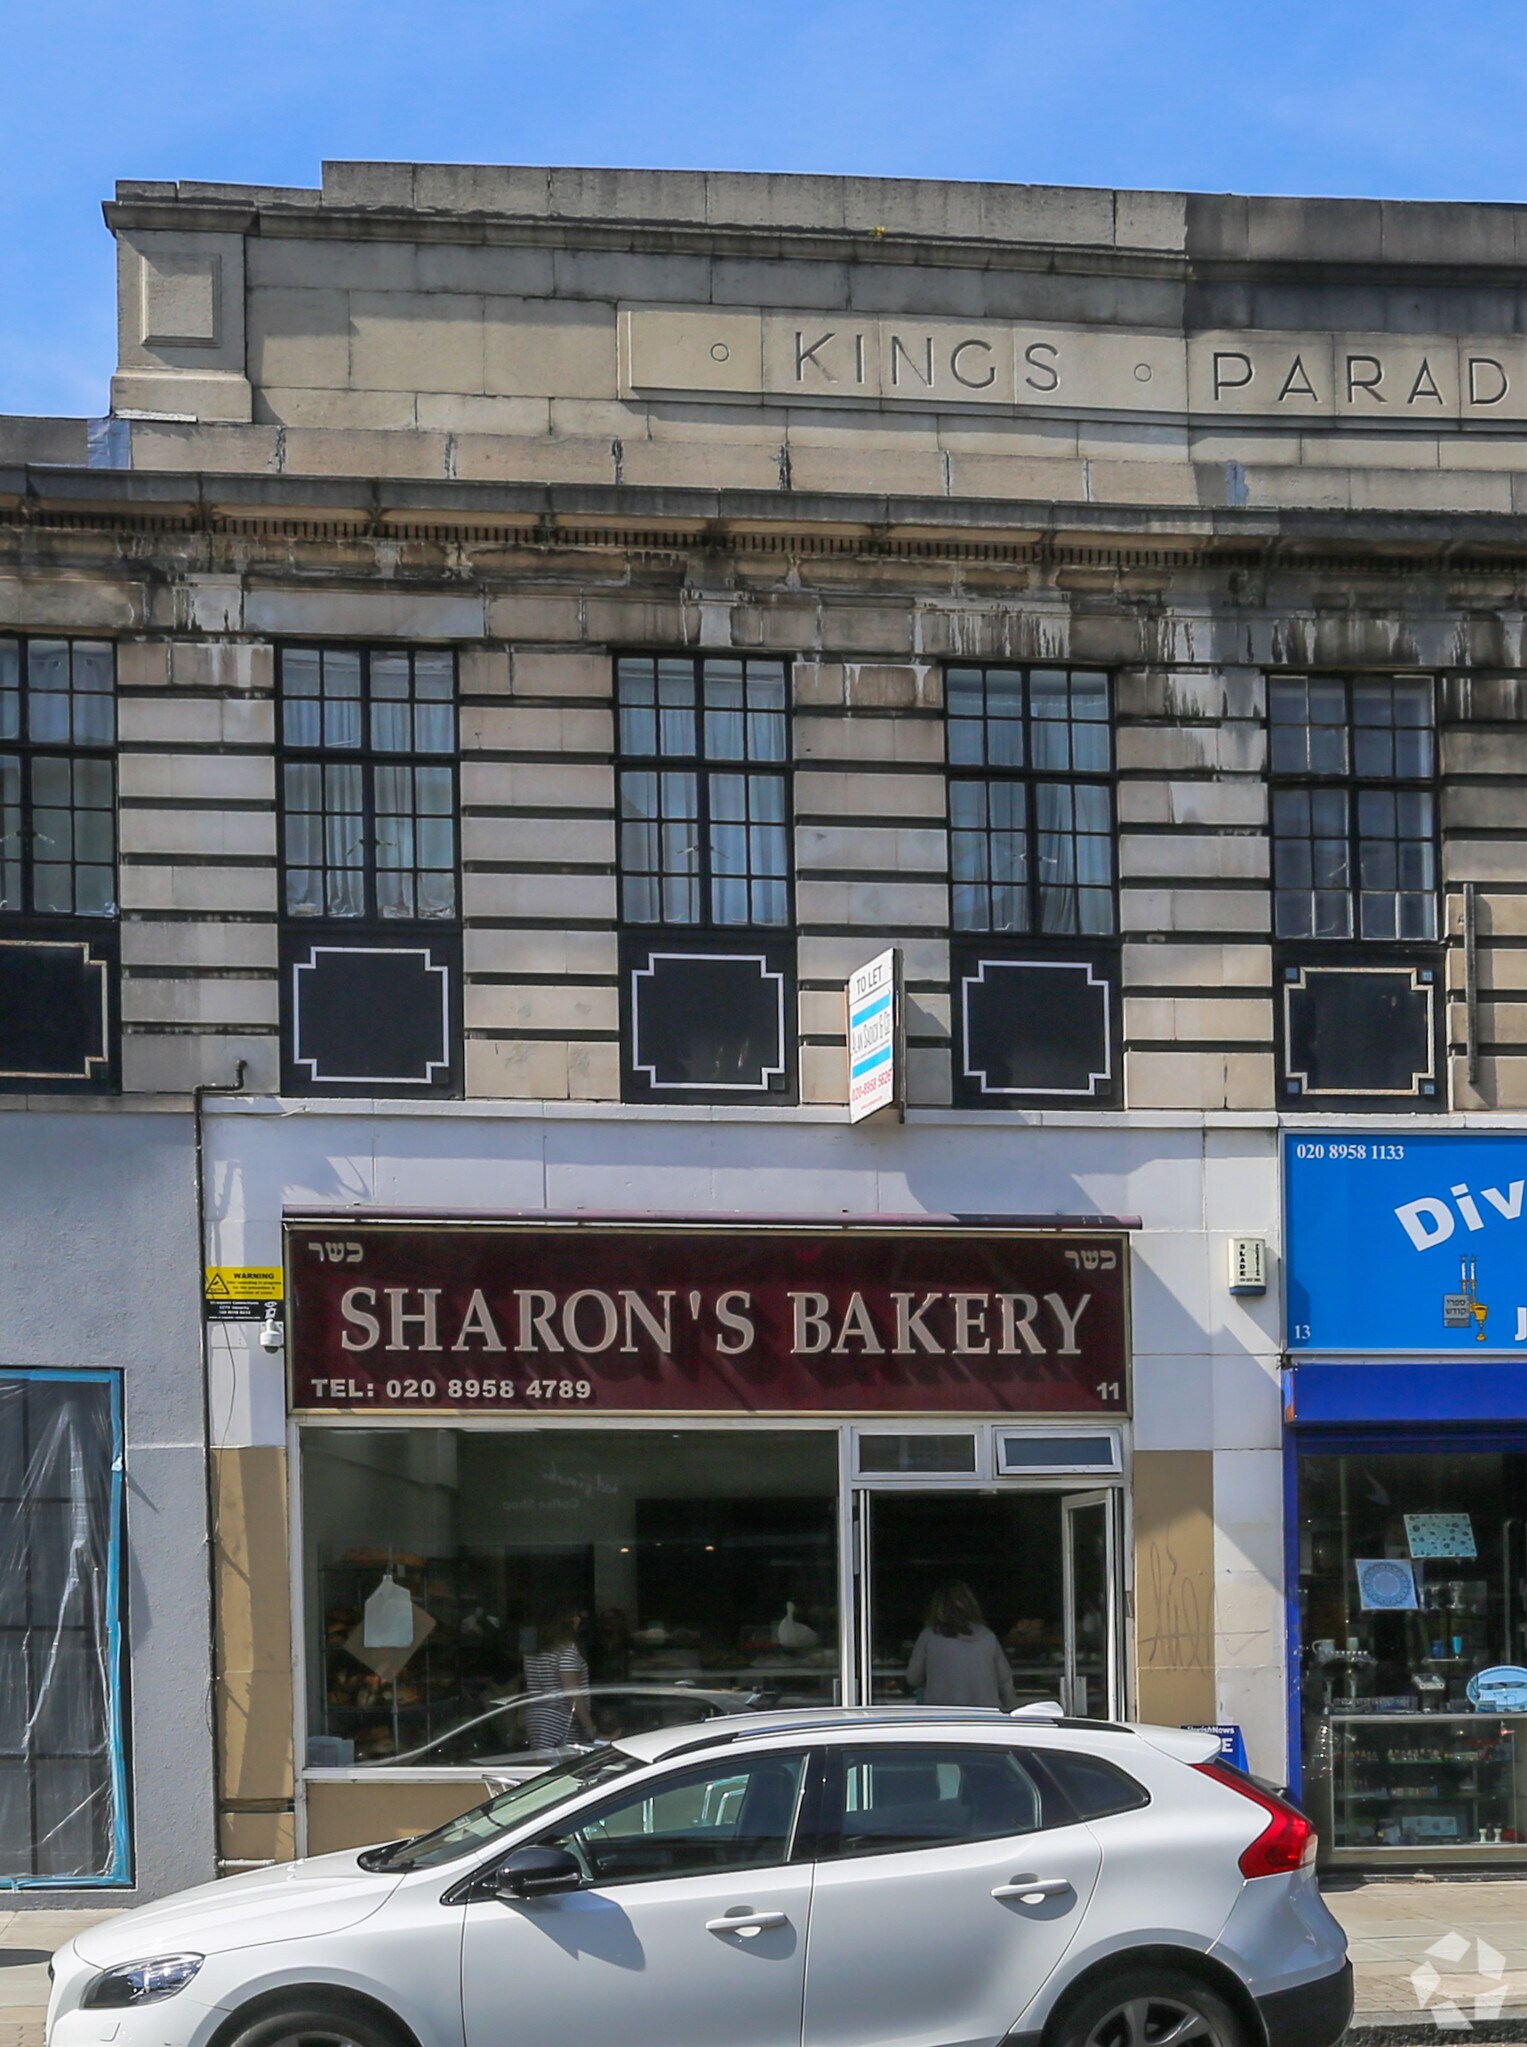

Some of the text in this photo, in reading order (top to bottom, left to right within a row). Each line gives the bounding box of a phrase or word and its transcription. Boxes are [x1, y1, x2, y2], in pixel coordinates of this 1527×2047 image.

[794, 331, 1509, 407] KINGS PARAD
[857, 964, 883, 995] TO LET
[1296, 1144, 1405, 1160] 020 8958 1133
[308, 1241, 364, 1263] כשר
[1064, 1249, 1117, 1270] כשר
[341, 1286, 1091, 1355] SHARON'S BAKERY
[1295, 1325, 1311, 1339] 13
[311, 1379, 591, 1399] TEL: 020 8958 4789
[1097, 1382, 1120, 1400] 11
